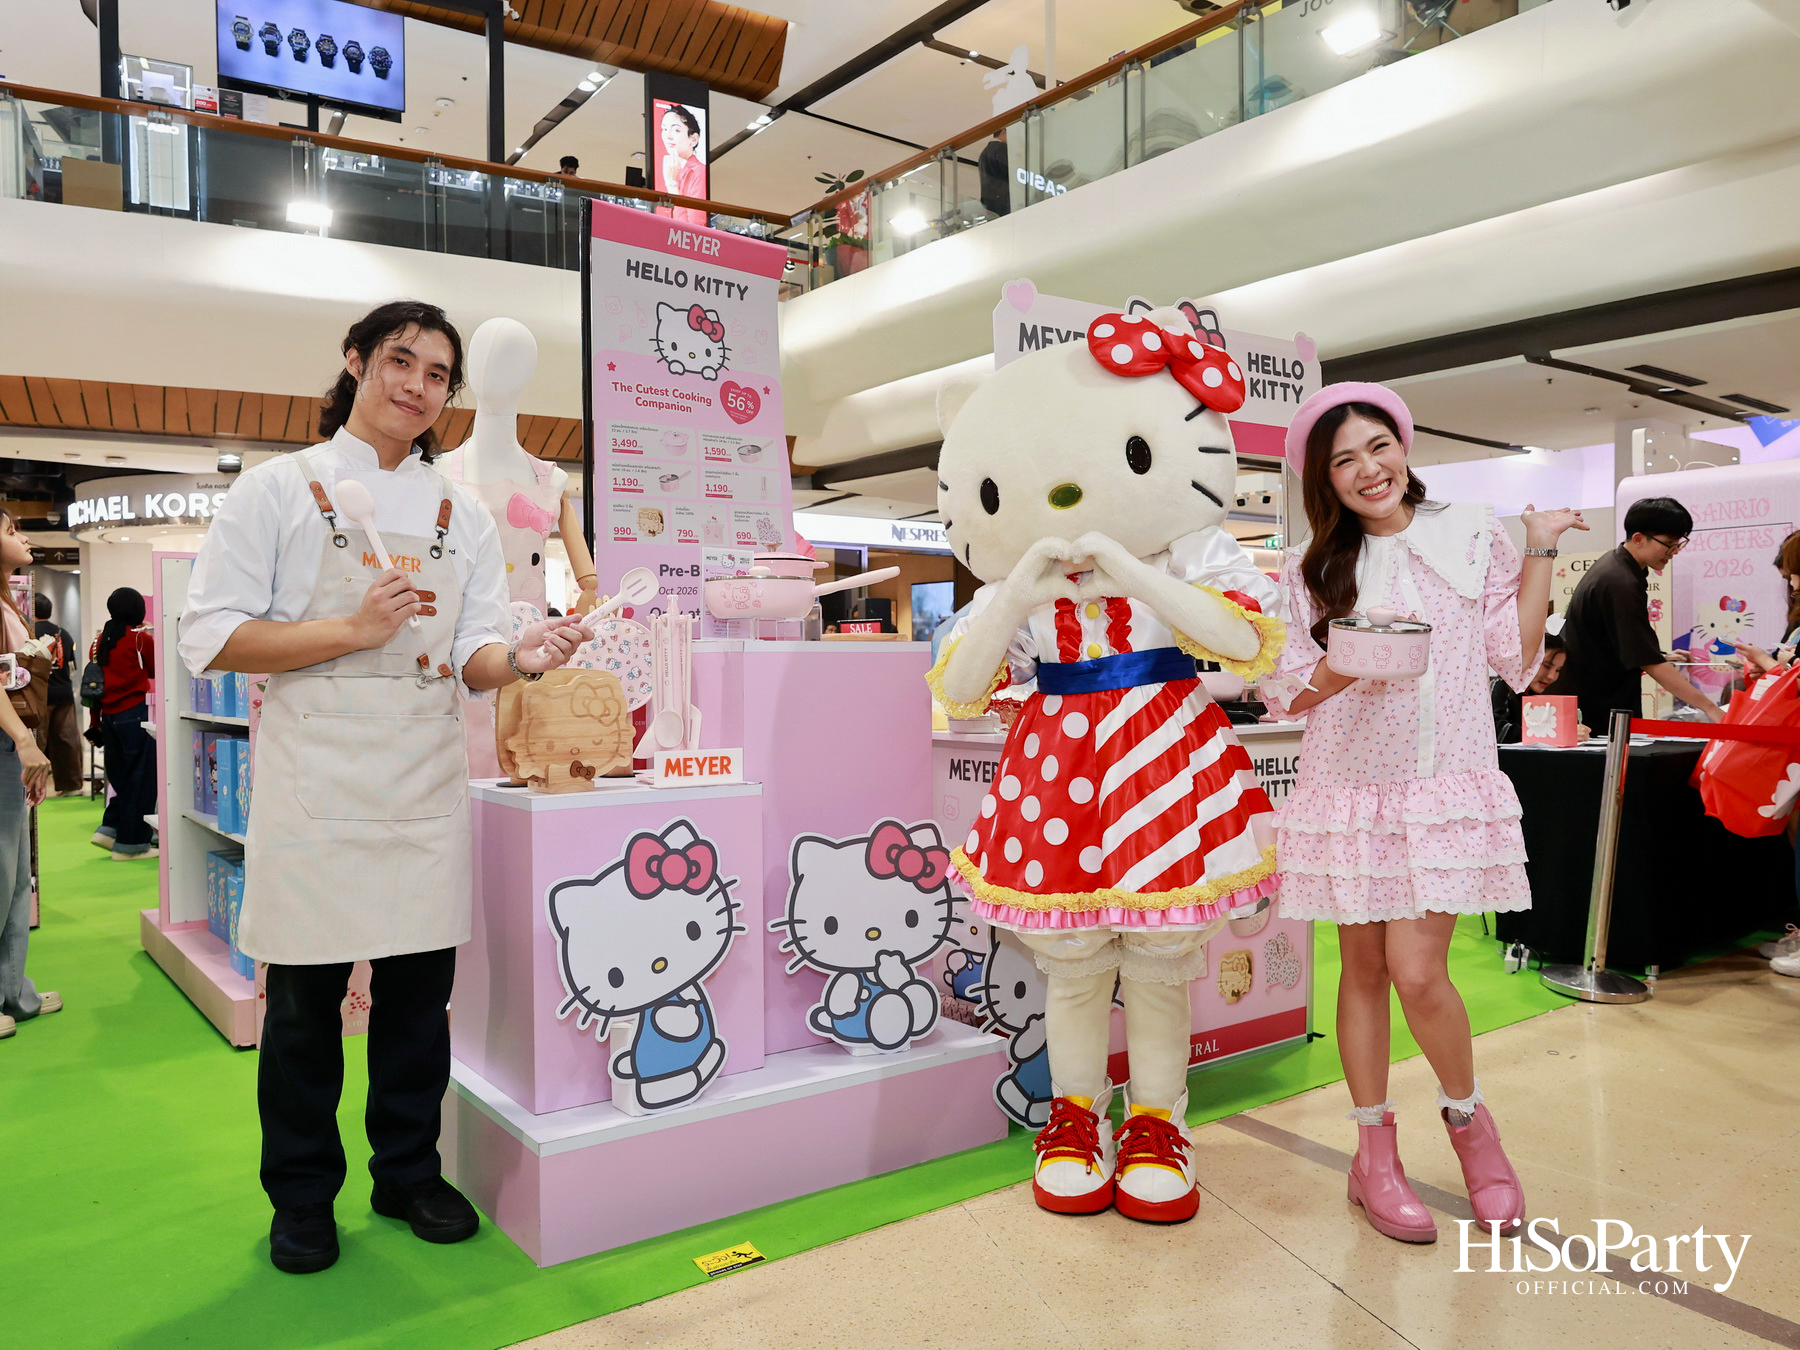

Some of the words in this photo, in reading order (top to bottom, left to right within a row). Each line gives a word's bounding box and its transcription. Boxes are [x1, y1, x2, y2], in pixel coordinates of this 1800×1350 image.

[1300, 0, 1333, 17] JO
[667, 228, 721, 257] MEYER
[626, 258, 688, 288] HELLO
[694, 274, 748, 301] KITTY
[1248, 352, 1304, 380] HELLO
[611, 382, 633, 392] The
[635, 384, 670, 397] Cutest
[672, 389, 712, 407] Cooking
[1250, 377, 1303, 404] KITTY
[635, 397, 692, 413] Companion
[611, 438, 638, 448] 3,490
[704, 447, 727, 456] 1,590
[613, 477, 639, 487] 1,190
[705, 483, 728, 493] 1,190
[1689, 498, 1770, 524] SANRIO
[613, 526, 632, 536] 990
[677, 529, 694, 538] 790
[736, 531, 752, 540] 690
[1684, 528, 1775, 553] ACTERS
[1703, 559, 1755, 579] 2026
[658, 587, 674, 595] Oct
[676, 587, 698, 595] 2026
[1647, 582, 1661, 591] IR
[849, 623, 873, 634] SALE
[664, 756, 732, 777] MEYER
[1254, 756, 1300, 776] HELLO
